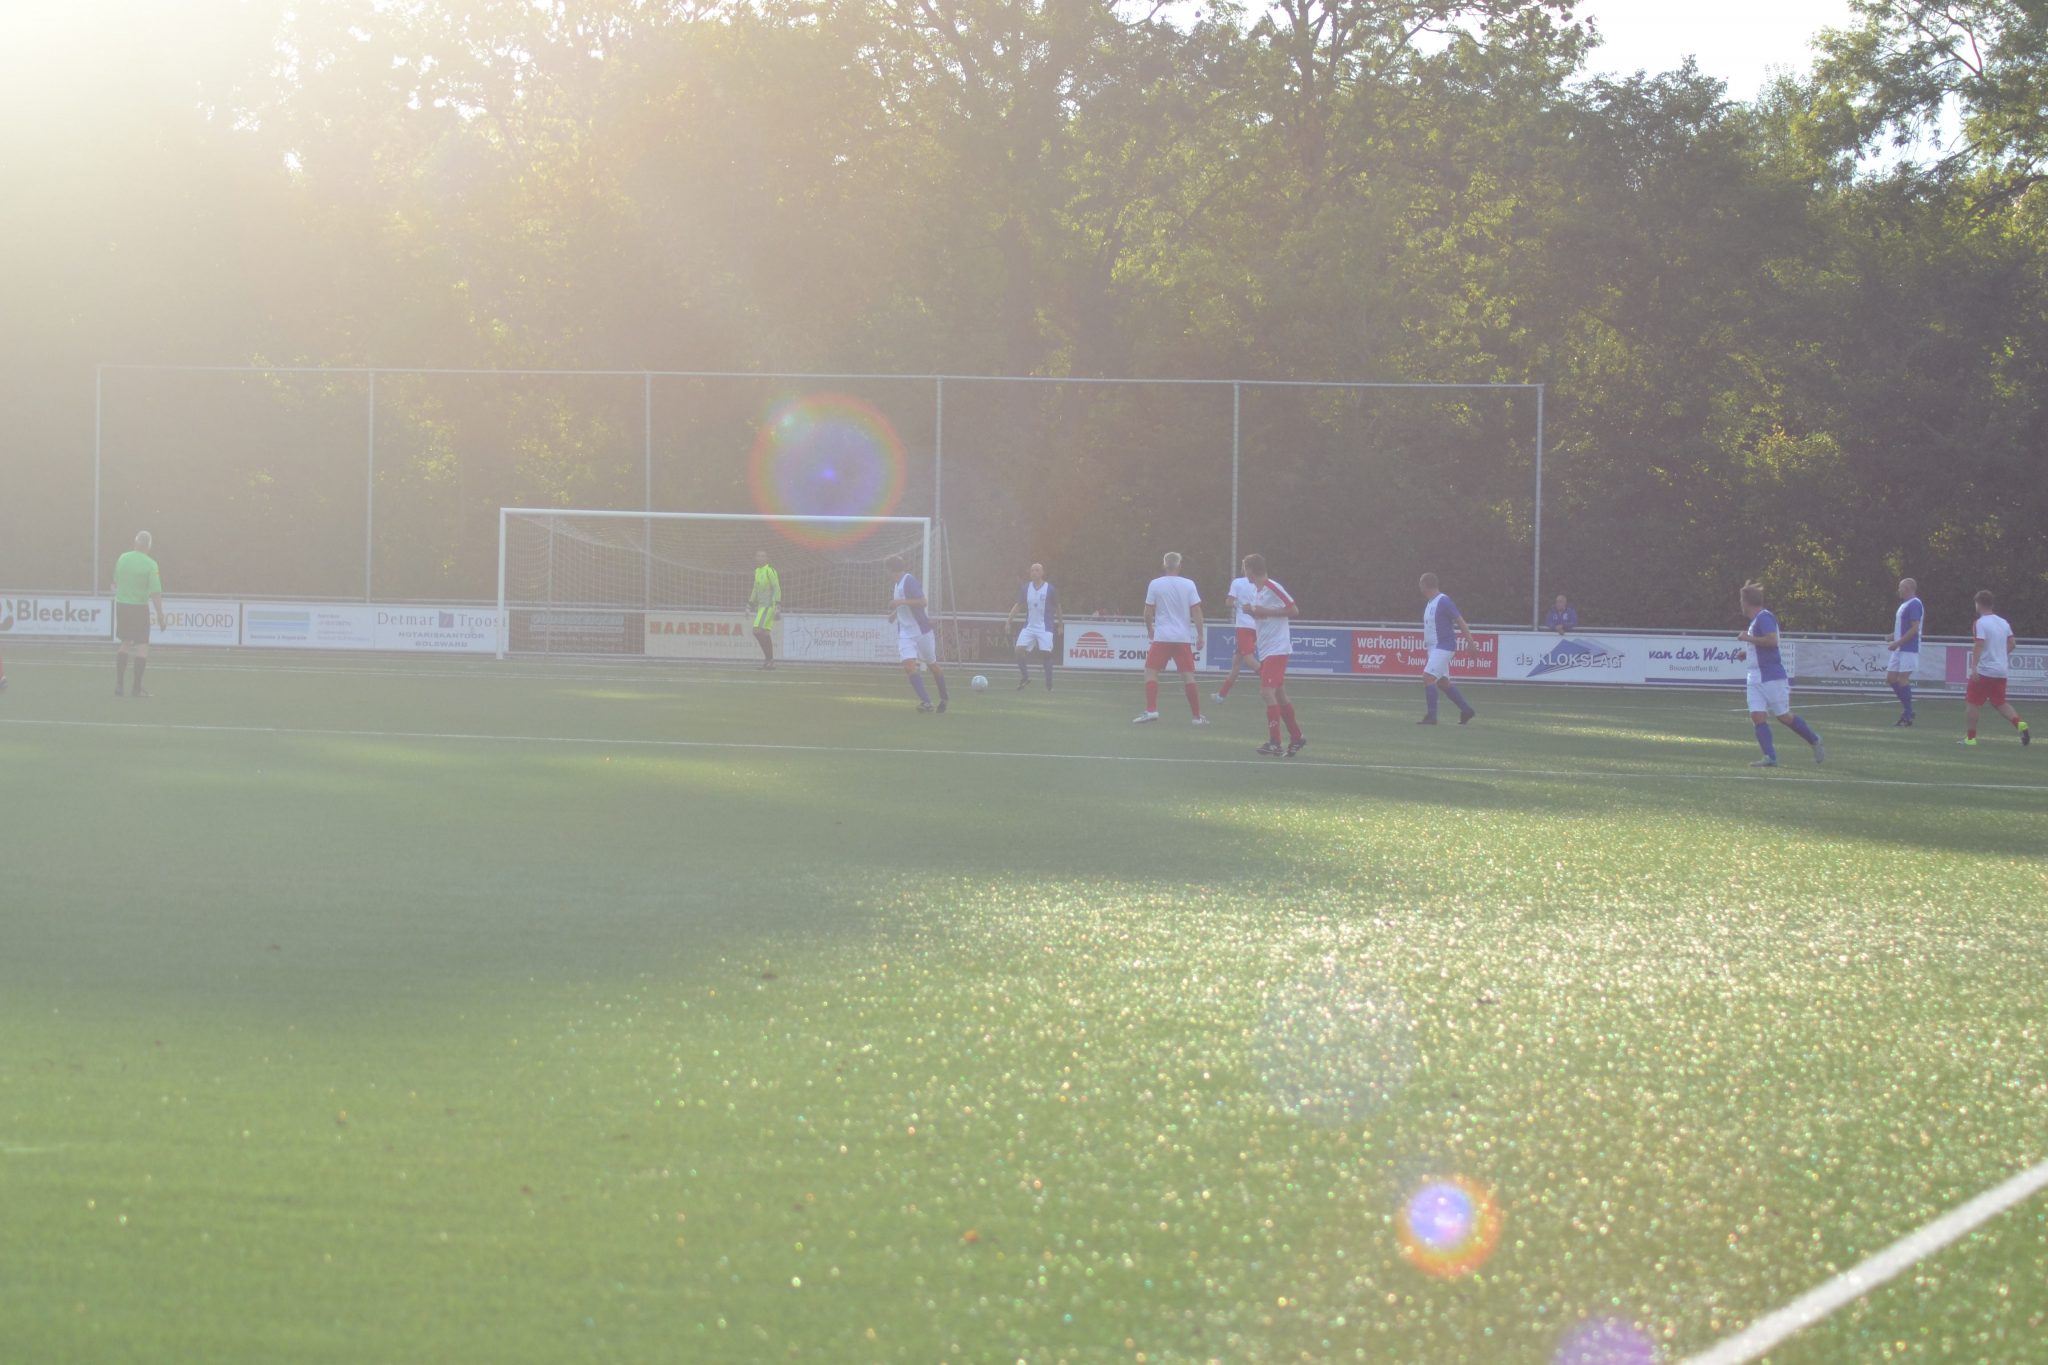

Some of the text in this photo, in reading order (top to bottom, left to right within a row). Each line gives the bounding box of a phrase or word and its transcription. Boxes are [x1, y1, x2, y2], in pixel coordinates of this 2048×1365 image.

[17, 599, 101, 622] Bleeker
[150, 611, 233, 628] GOENOORD
[377, 612, 435, 625] Detmar
[814, 628, 881, 641] Fysiotherapie
[1291, 637, 1337, 648] PTIEK
[1069, 648, 1115, 659] HANZE
[1648, 651, 1672, 660] van
[1676, 648, 1699, 661] der
[1450, 657, 1465, 667] vind
[1467, 657, 1475, 669] je
[1476, 659, 1492, 668] hier
[1516, 653, 1623, 669] de KLOKSLAG
[1832, 658, 1860, 673] Van
